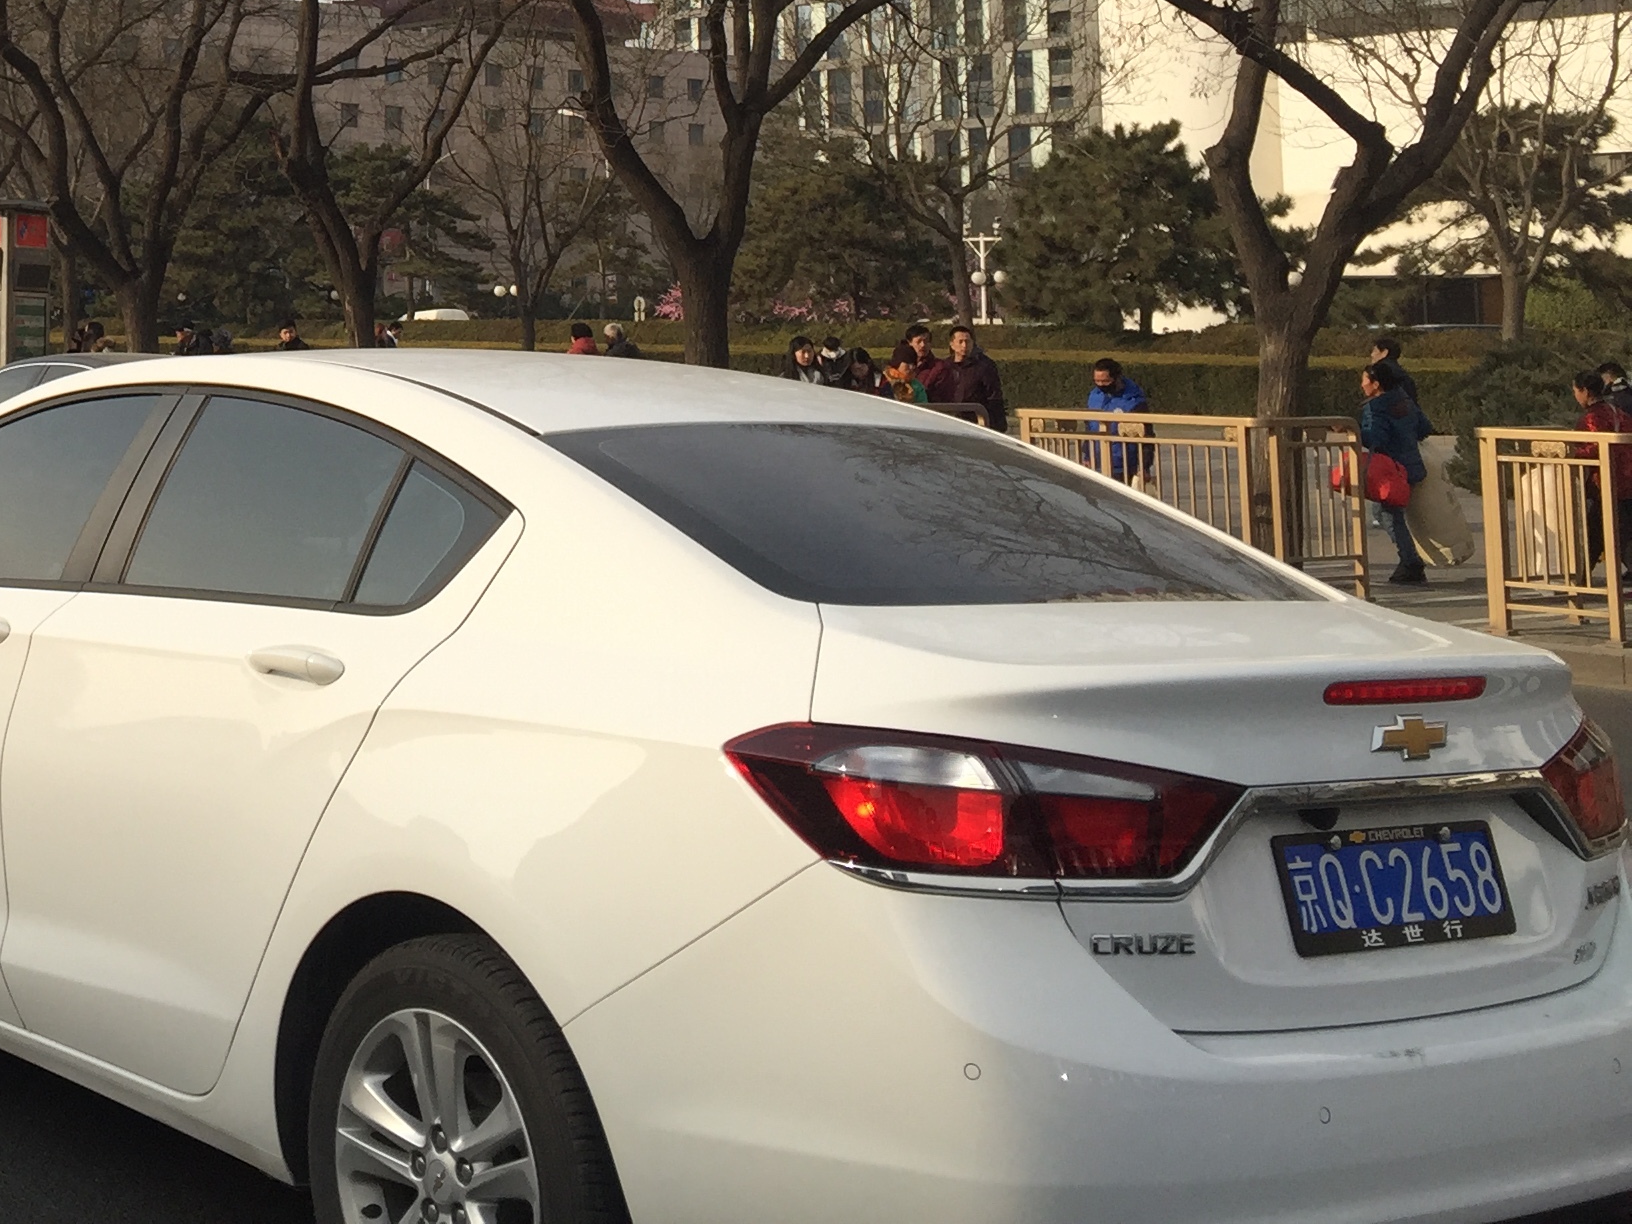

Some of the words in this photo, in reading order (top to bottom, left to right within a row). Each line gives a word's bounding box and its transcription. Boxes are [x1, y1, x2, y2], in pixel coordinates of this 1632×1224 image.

[1368, 827, 1425, 842] CHEVROLET
[1090, 933, 1196, 955] CRUZE
[1361, 919, 1463, 948] 达世行
